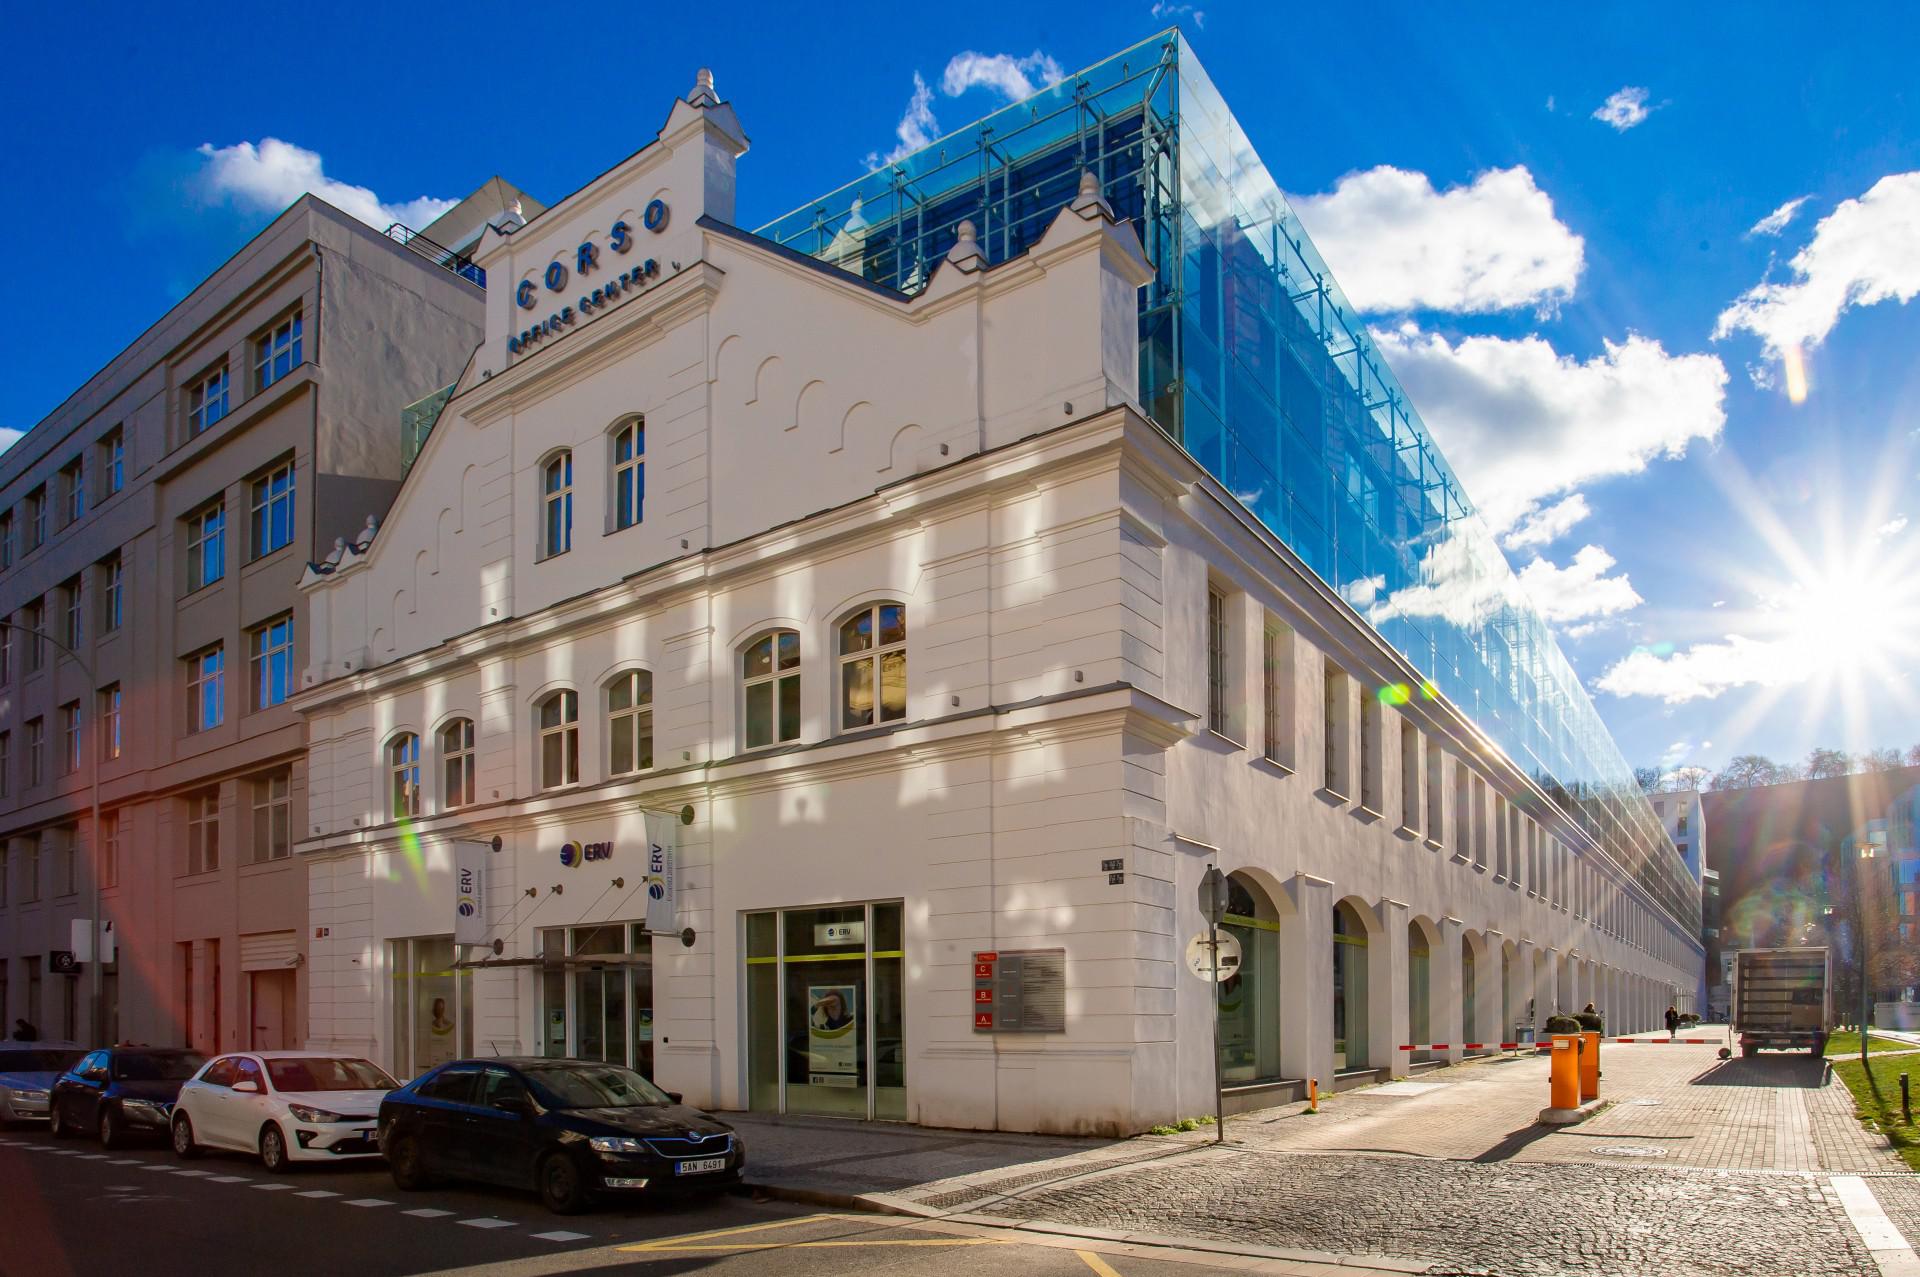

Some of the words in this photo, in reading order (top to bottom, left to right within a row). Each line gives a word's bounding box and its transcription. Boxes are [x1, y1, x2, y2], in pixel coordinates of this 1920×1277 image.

[516, 199, 669, 311] CORSO
[509, 306, 577, 355] OFFICE
[579, 258, 661, 315] CENTER
[584, 841, 614, 862] ERV
[651, 843, 663, 873] ERV
[460, 868, 472, 894] ERV
[839, 928, 851, 936] ERV
[682, 1161, 698, 1172] 5AN
[703, 1159, 721, 1170] 6491
